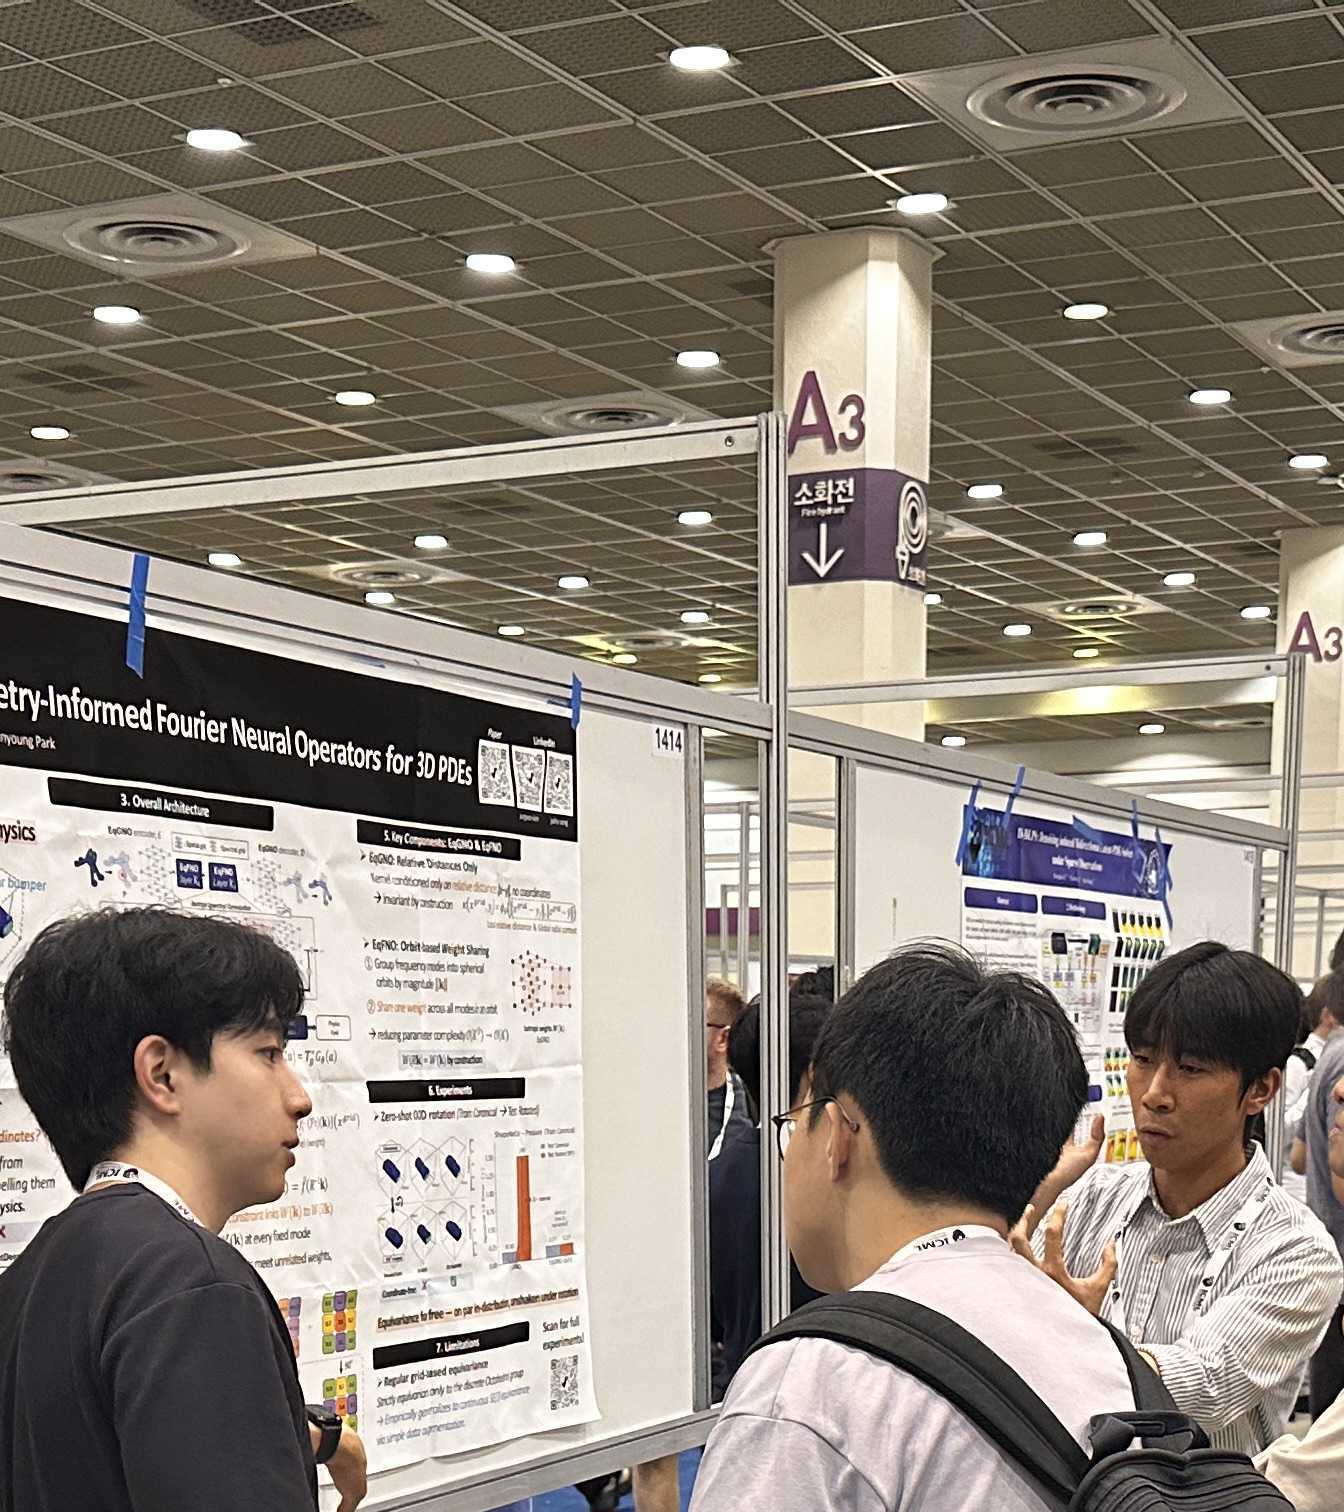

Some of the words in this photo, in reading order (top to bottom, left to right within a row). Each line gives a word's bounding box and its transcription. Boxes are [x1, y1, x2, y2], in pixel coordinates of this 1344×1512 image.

[788, 370, 865, 459] A3
[793, 477, 855, 506] 소화전
[1288, 611, 1343, 663] A3
[36, 735, 56, 750] Park
[157, 703, 228, 744] Fourier
[232, 717, 291, 755] Neural
[295, 730, 381, 772] Operators
[385, 744, 413, 776] for
[416, 751, 435, 779] 3D
[439, 756, 472, 785] PDEs
[656, 728, 682, 752] 1414
[120, 793, 131, 807] 3.
[133, 795, 162, 811] Overall
[163, 798, 209, 817] Architecture
[8, 876, 48, 893] bumper
[30, 1176, 55, 1190] them
[542, 1321, 559, 1333] Scan
